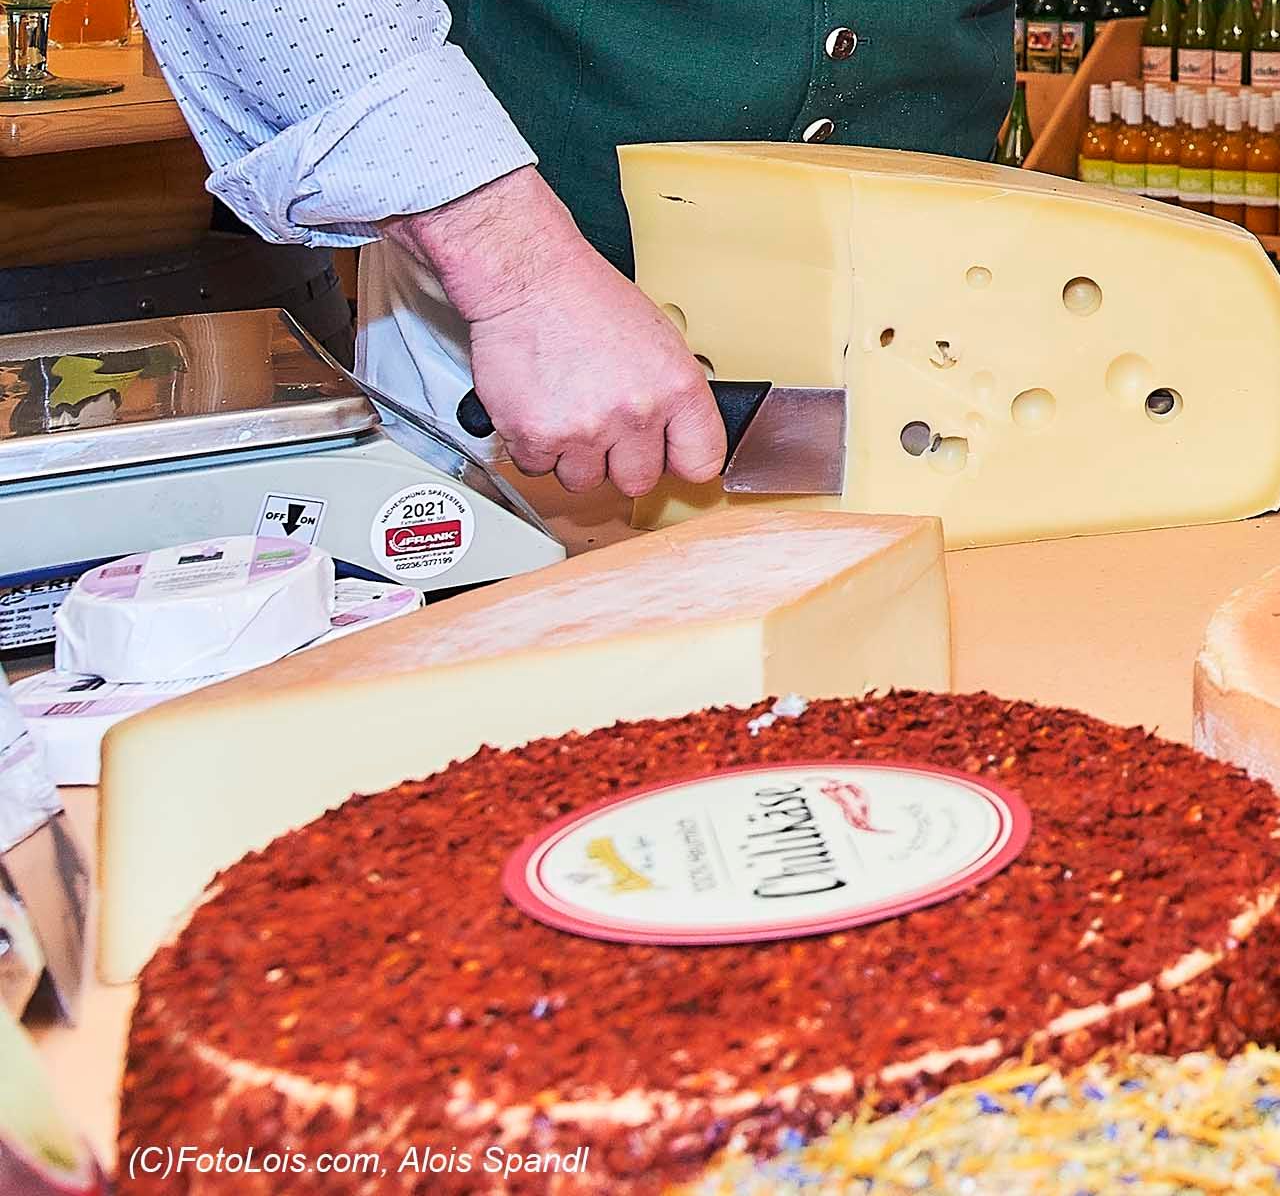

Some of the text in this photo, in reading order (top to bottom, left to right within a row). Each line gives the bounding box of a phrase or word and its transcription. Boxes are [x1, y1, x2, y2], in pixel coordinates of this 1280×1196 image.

[381, 489, 466, 523] NACHEICHUNG SPÄTESTENS
[402, 500, 445, 519] 2021
[265, 511, 316, 525] OFF ON
[405, 532, 456, 546] FRANK
[741, 786, 847, 899] Chilikäse
